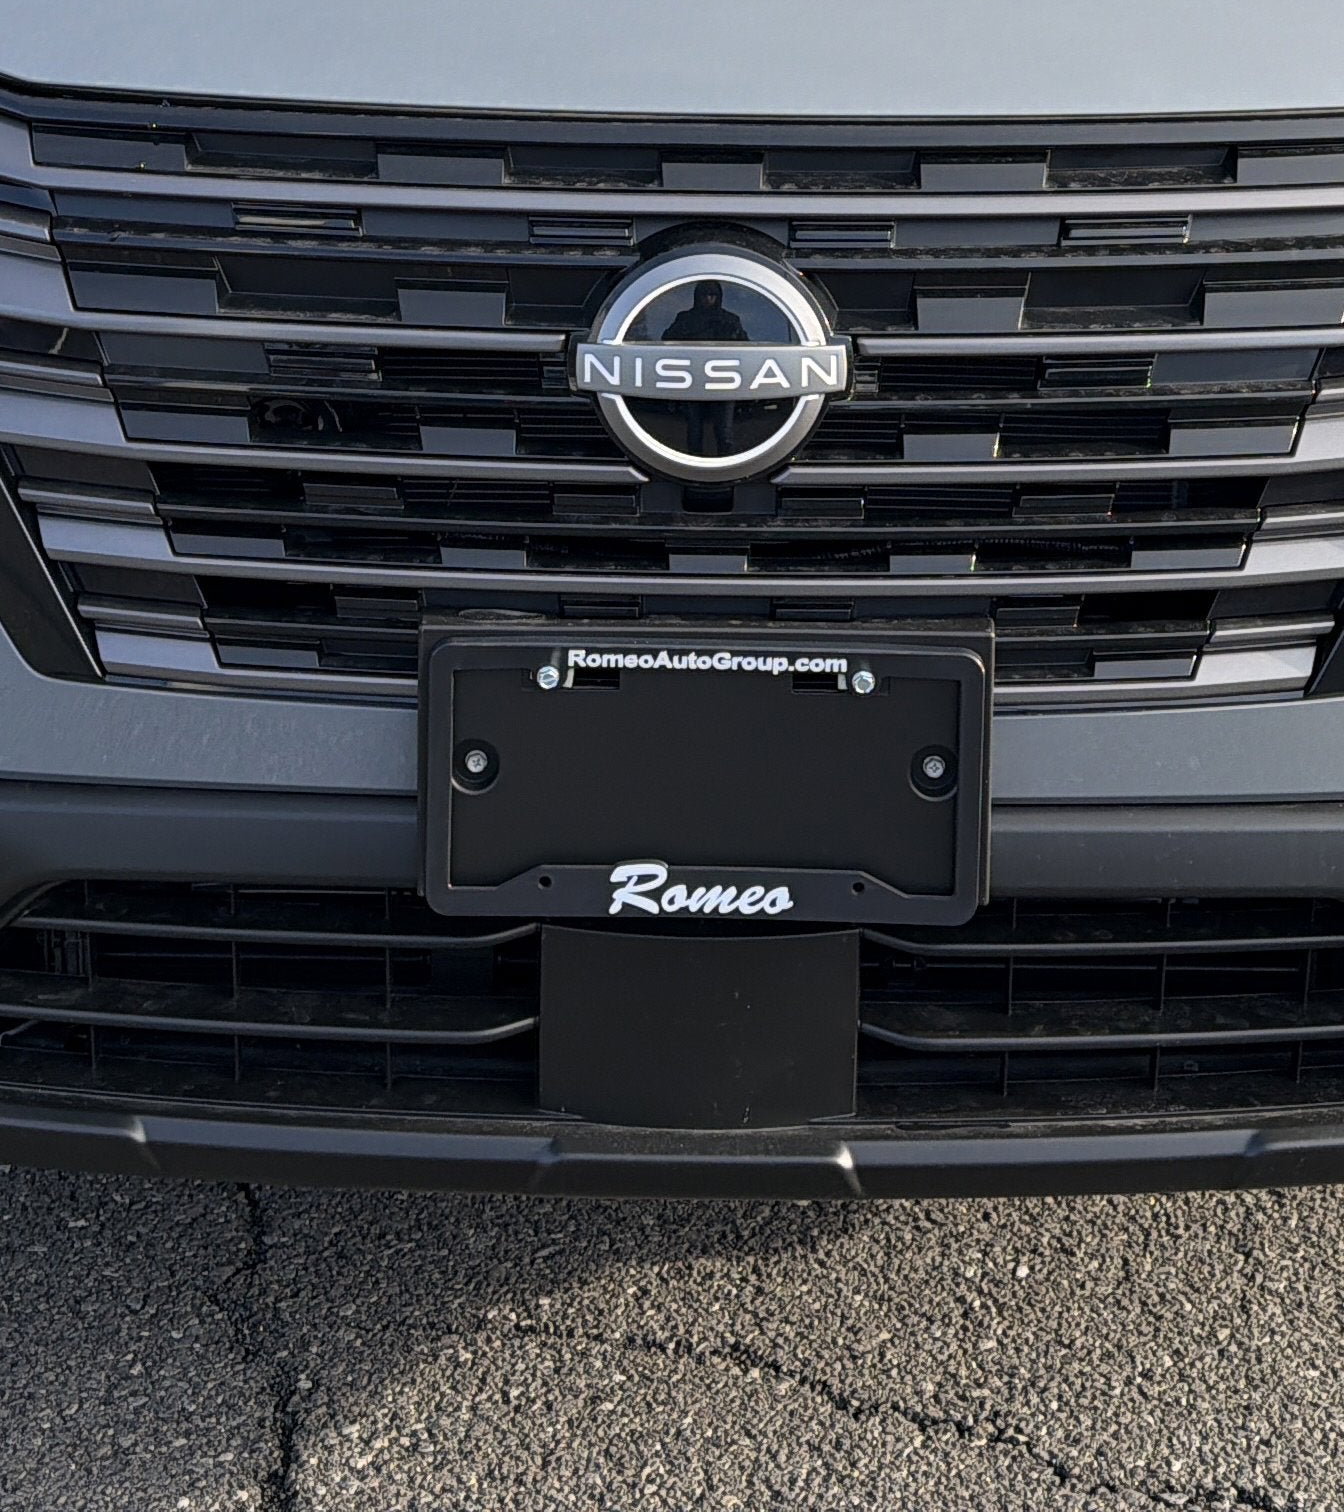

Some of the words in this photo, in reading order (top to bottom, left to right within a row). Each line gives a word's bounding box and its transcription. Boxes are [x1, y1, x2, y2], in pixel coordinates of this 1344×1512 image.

[582, 353, 838, 390] NISSAN
[567, 649, 848, 675] RomeoAutoGroup.com
[608, 862, 795, 915] Romeo
